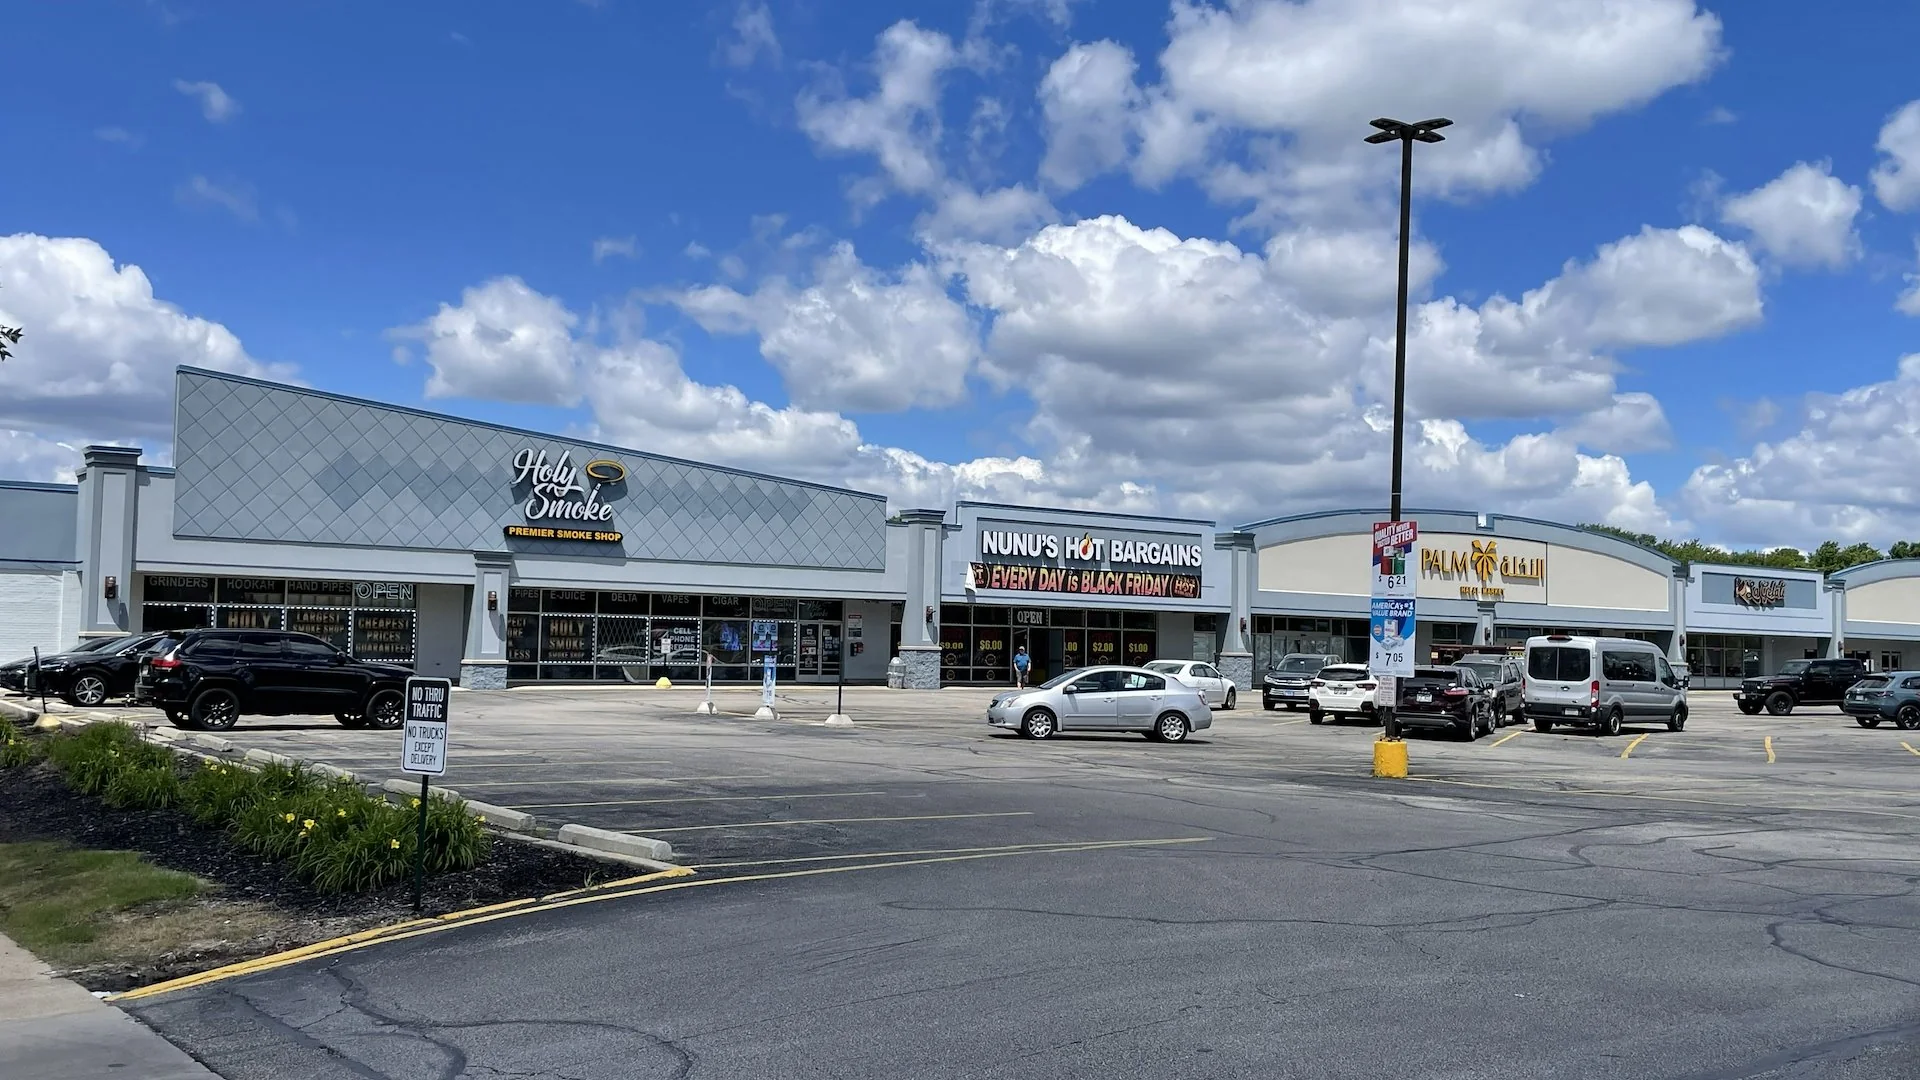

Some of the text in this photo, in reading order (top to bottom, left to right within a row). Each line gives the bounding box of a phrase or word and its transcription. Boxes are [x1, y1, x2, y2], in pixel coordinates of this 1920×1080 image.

[510, 448, 585, 498] Holy
[525, 482, 613, 520] Smoke
[509, 526, 622, 541] PREMIER SMOKE SHOP
[1374, 523, 1396, 542] QUALITY
[1390, 528, 1413, 546] BETTER
[982, 530, 1202, 567] NUNU'S HOT BARGAINS
[1421, 548, 1469, 573] PALM
[149, 577, 209, 588] GRINDERS
[226, 579, 275, 590] HOOKAH
[288, 581, 352, 592] HAND PIPES
[991, 565, 1035, 589] EVERY
[1038, 568, 1064, 591] DAY
[1067, 571, 1079, 592] is
[1080, 571, 1122, 594] BLACK
[1125, 573, 1170, 597] FRIDAY
[356, 582, 414, 600] OPEN
[515, 590, 539, 599] PIPES
[550, 591, 586, 601] E-JUICE
[611, 593, 638, 602] DELTA
[661, 595, 690, 604] VAPES
[712, 596, 739, 606] CIGAR
[297, 612, 341, 623] LARGEST
[1017, 611, 1043, 624] OPEN
[1372, 609, 1413, 618] VALUE BRAND
[358, 618, 410, 630] CHEAPEST
[549, 619, 585, 637] HOLY
[366, 630, 401, 641] PRICES
[670, 635, 696, 643] PHONE
[356, 643, 411, 653] GUARANTEED
[549, 638, 585, 650] SMOKE
[979, 639, 1003, 651] $6.00
[1092, 642, 1114, 652] $2.00
[1128, 643, 1149, 653] $1.00
[412, 686, 444, 702] NO THRU
[412, 703, 442, 718] TRAFFIC
[408, 725, 444, 740] NO TRUCKS
[414, 741, 435, 752] EXCEPT
[411, 753, 437, 765] DELIVERY
